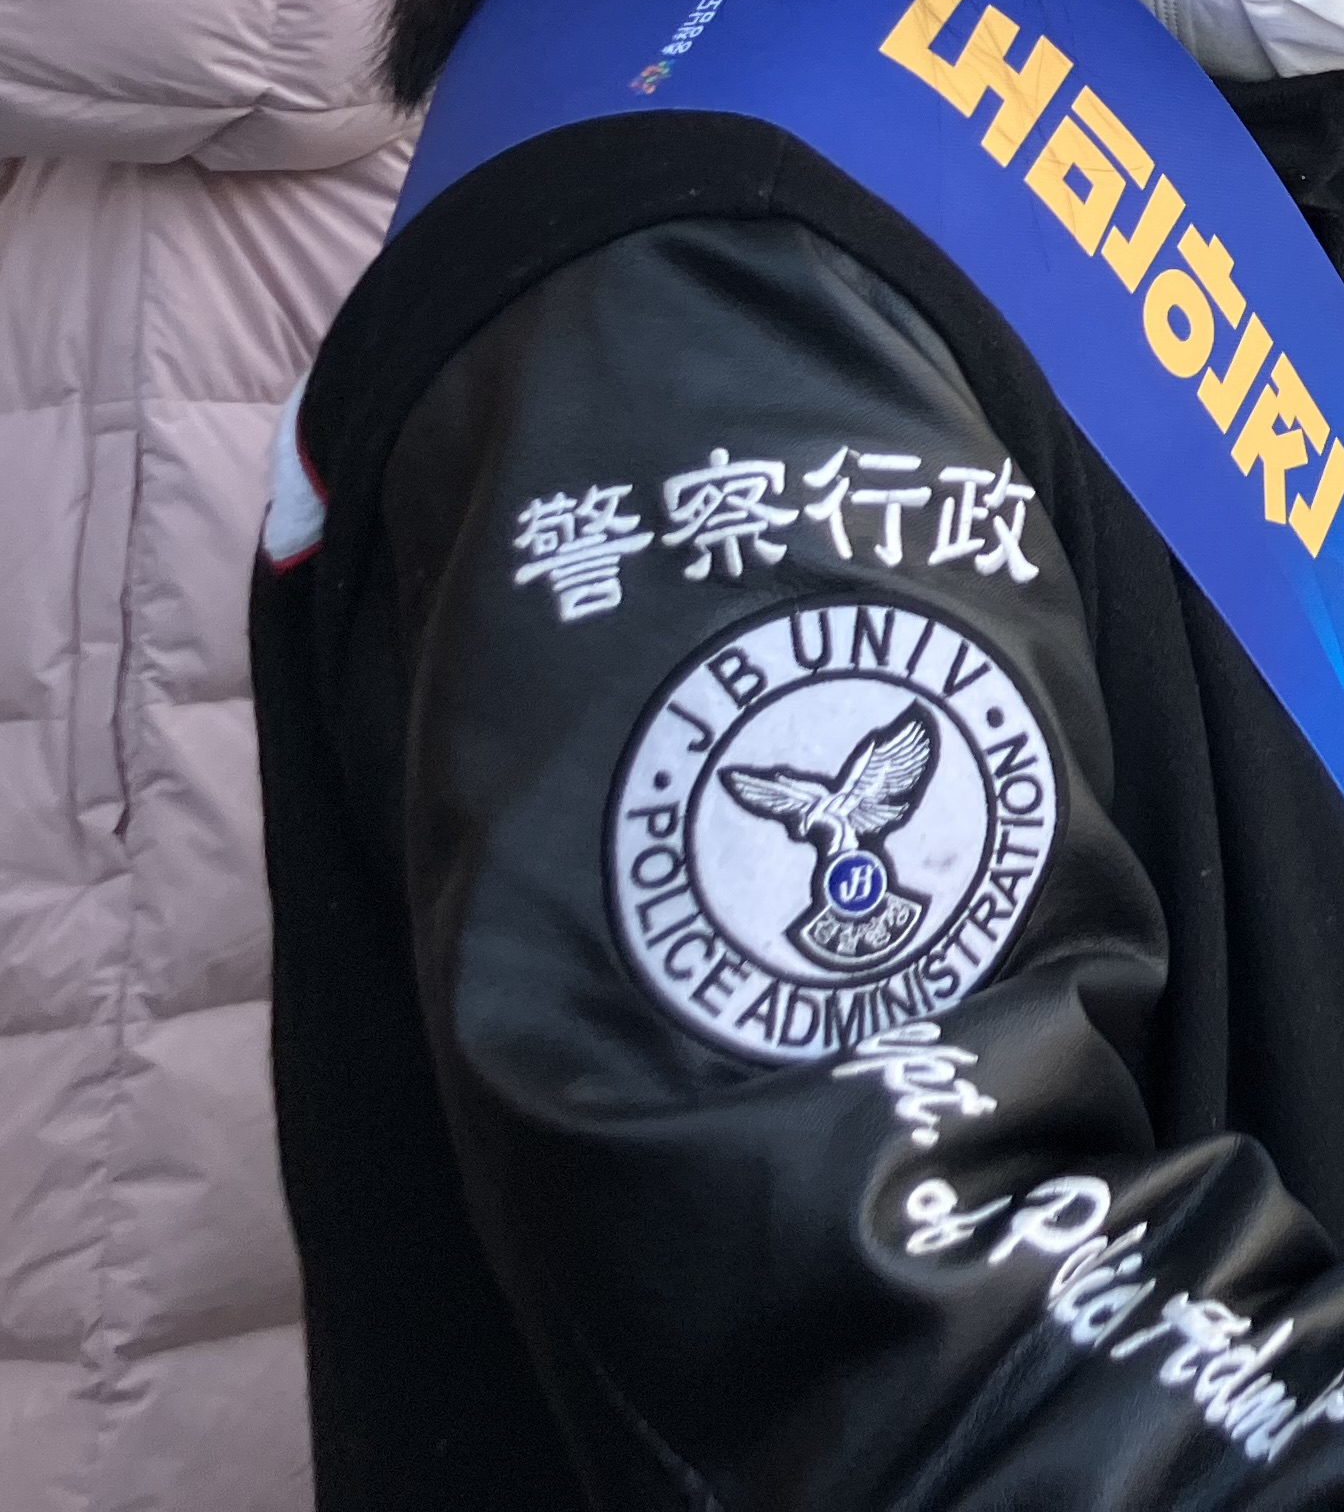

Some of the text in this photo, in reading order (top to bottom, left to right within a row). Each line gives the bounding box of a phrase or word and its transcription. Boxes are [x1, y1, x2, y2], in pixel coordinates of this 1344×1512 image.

[513, 445, 1040, 622] 警察行政
[663, 608, 994, 755] JB UNIV
[626, 730, 1046, 1054] POLICE ADMINISTRATION
